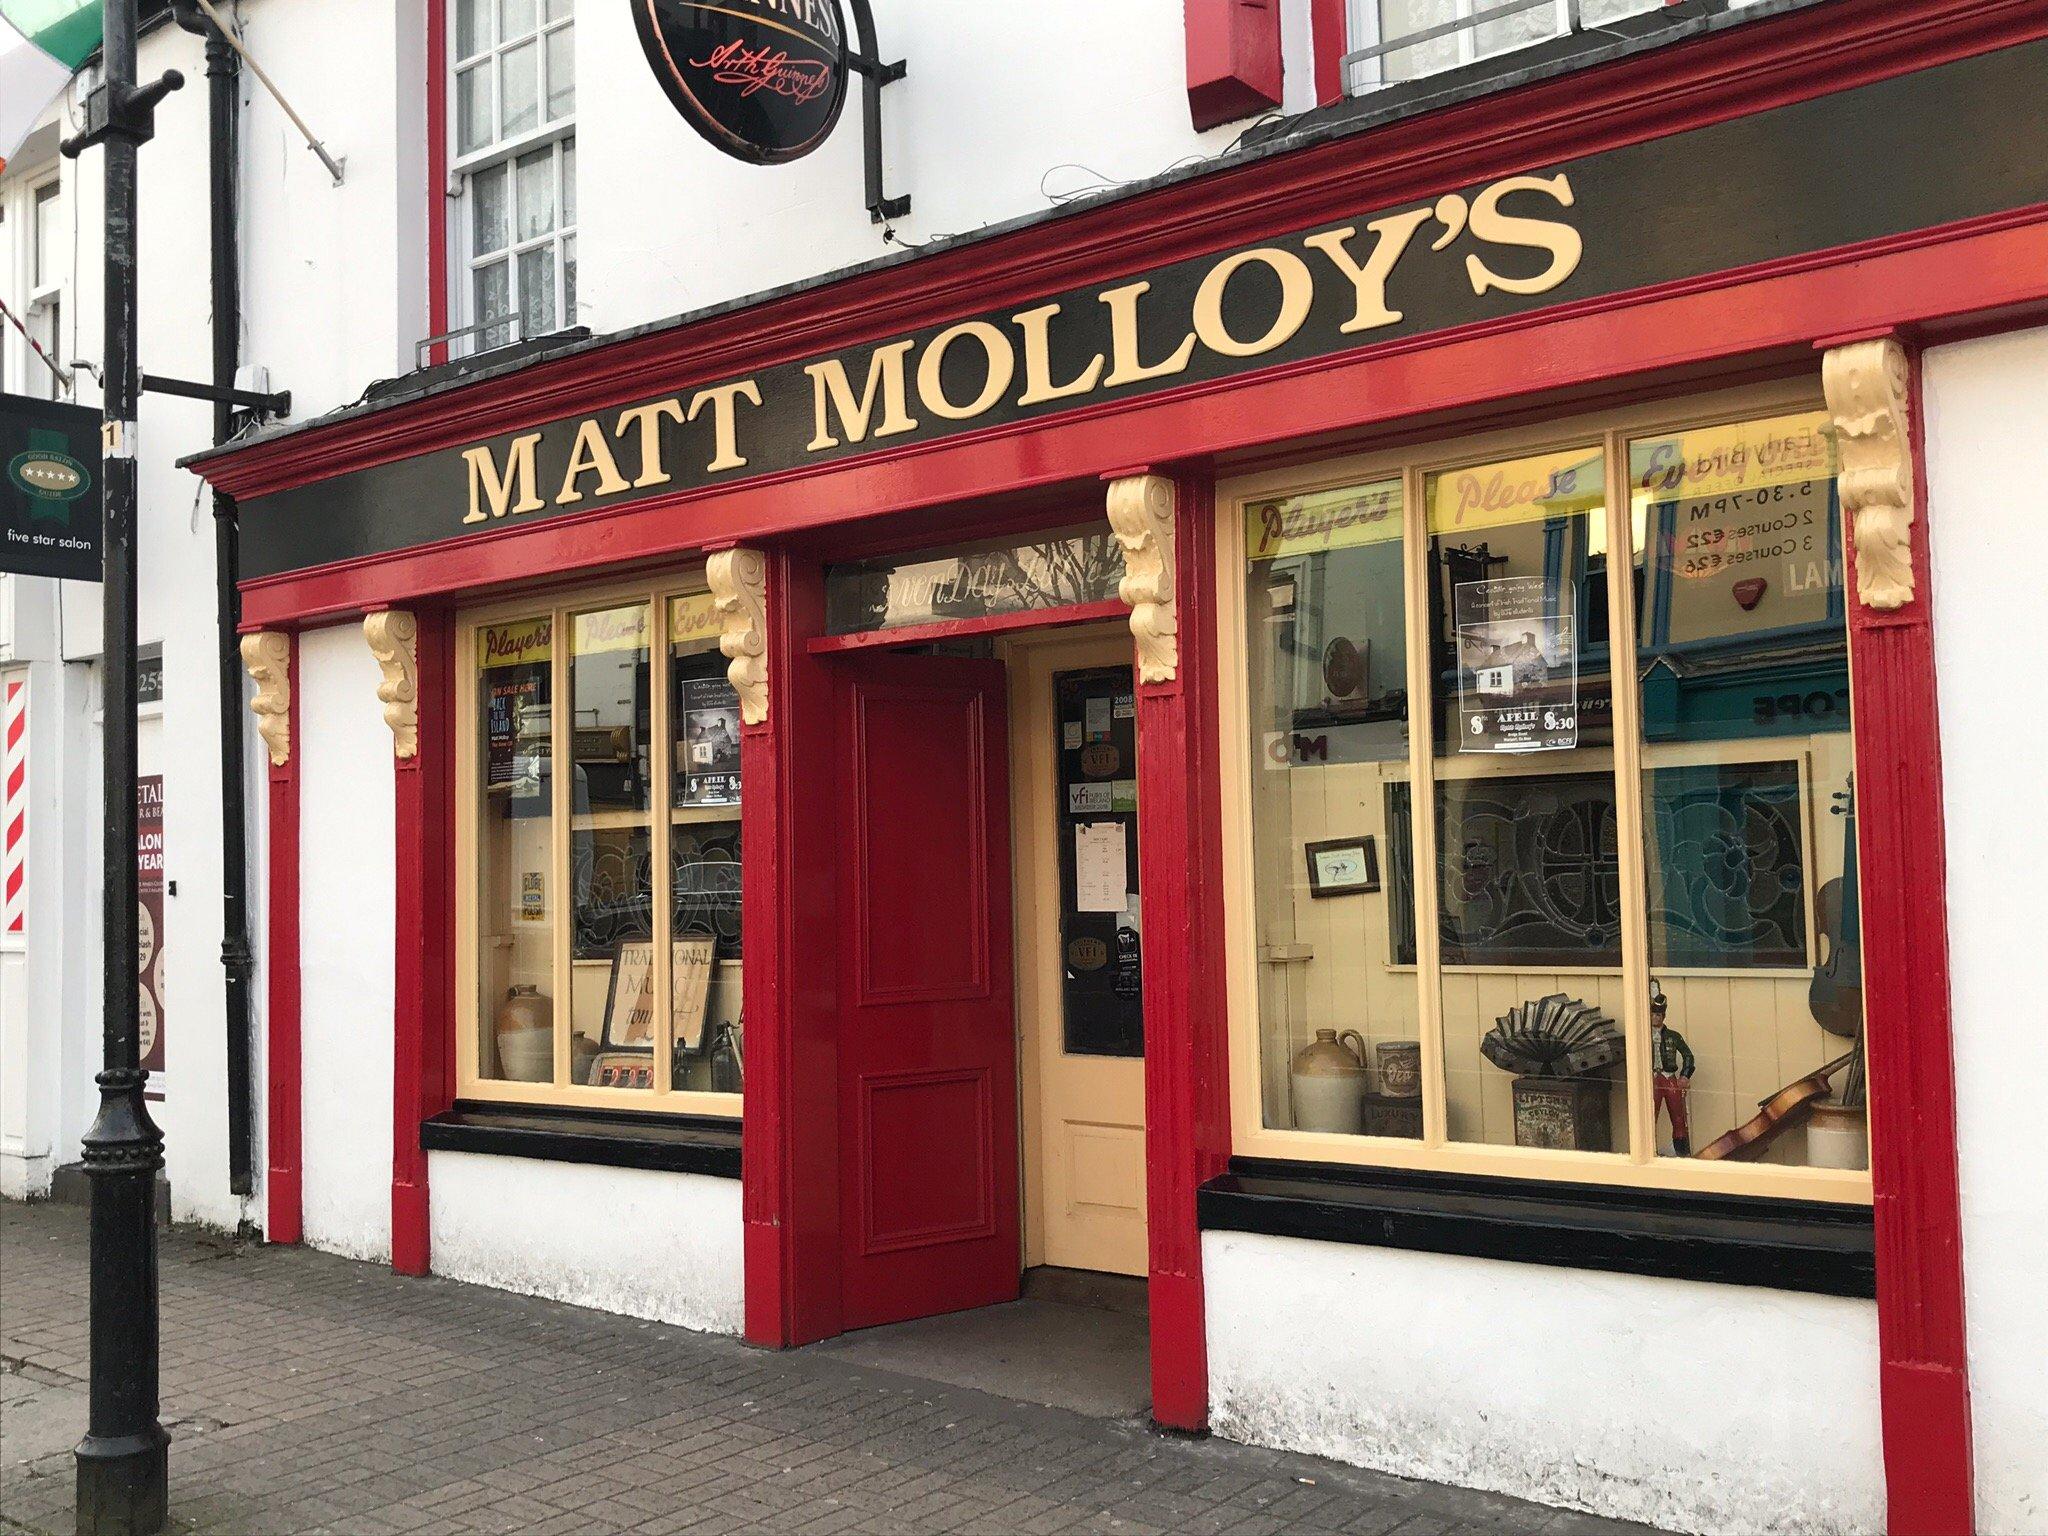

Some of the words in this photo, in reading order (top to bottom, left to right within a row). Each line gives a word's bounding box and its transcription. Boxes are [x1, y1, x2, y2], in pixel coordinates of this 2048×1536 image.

[462, 379, 763, 525] MATT
[804, 175, 1583, 453] MOLLOY'S
[106, 424, 115, 446] 1
[1455, 467, 1578, 524] Please
[7, 528, 29, 543] five
[33, 534, 56, 545] star
[59, 536, 91, 550] salon
[944, 561, 1008, 608] Day
[1497, 711, 1539, 723] APRIL
[1544, 711, 1574, 731] 8:30
[1072, 786, 1088, 804] vfi
